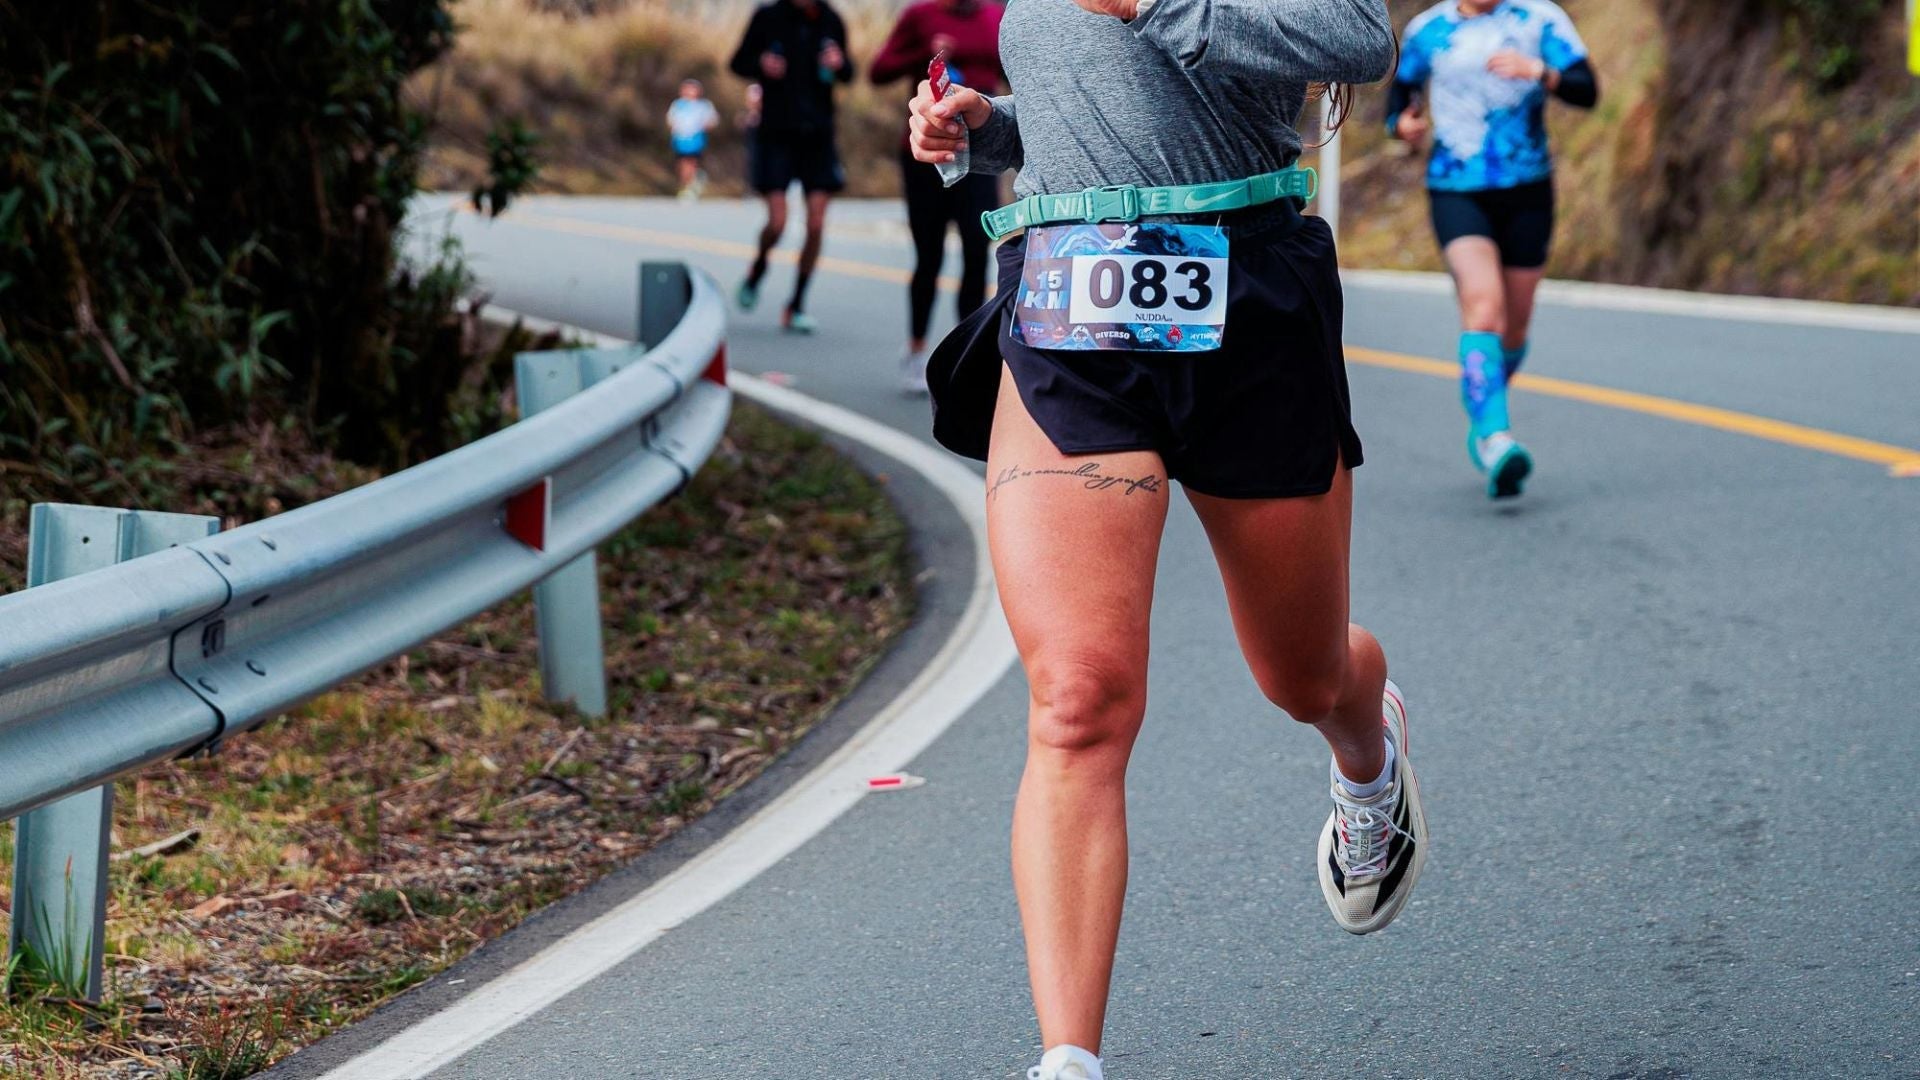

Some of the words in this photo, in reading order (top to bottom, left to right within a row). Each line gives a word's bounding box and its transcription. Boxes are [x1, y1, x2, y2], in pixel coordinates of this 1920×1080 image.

[1036, 270, 1063, 290] 15
[1089, 258, 1213, 311] 083
[1023, 290, 1069, 309] KM
[1095, 330, 1131, 340] DIVERSO
